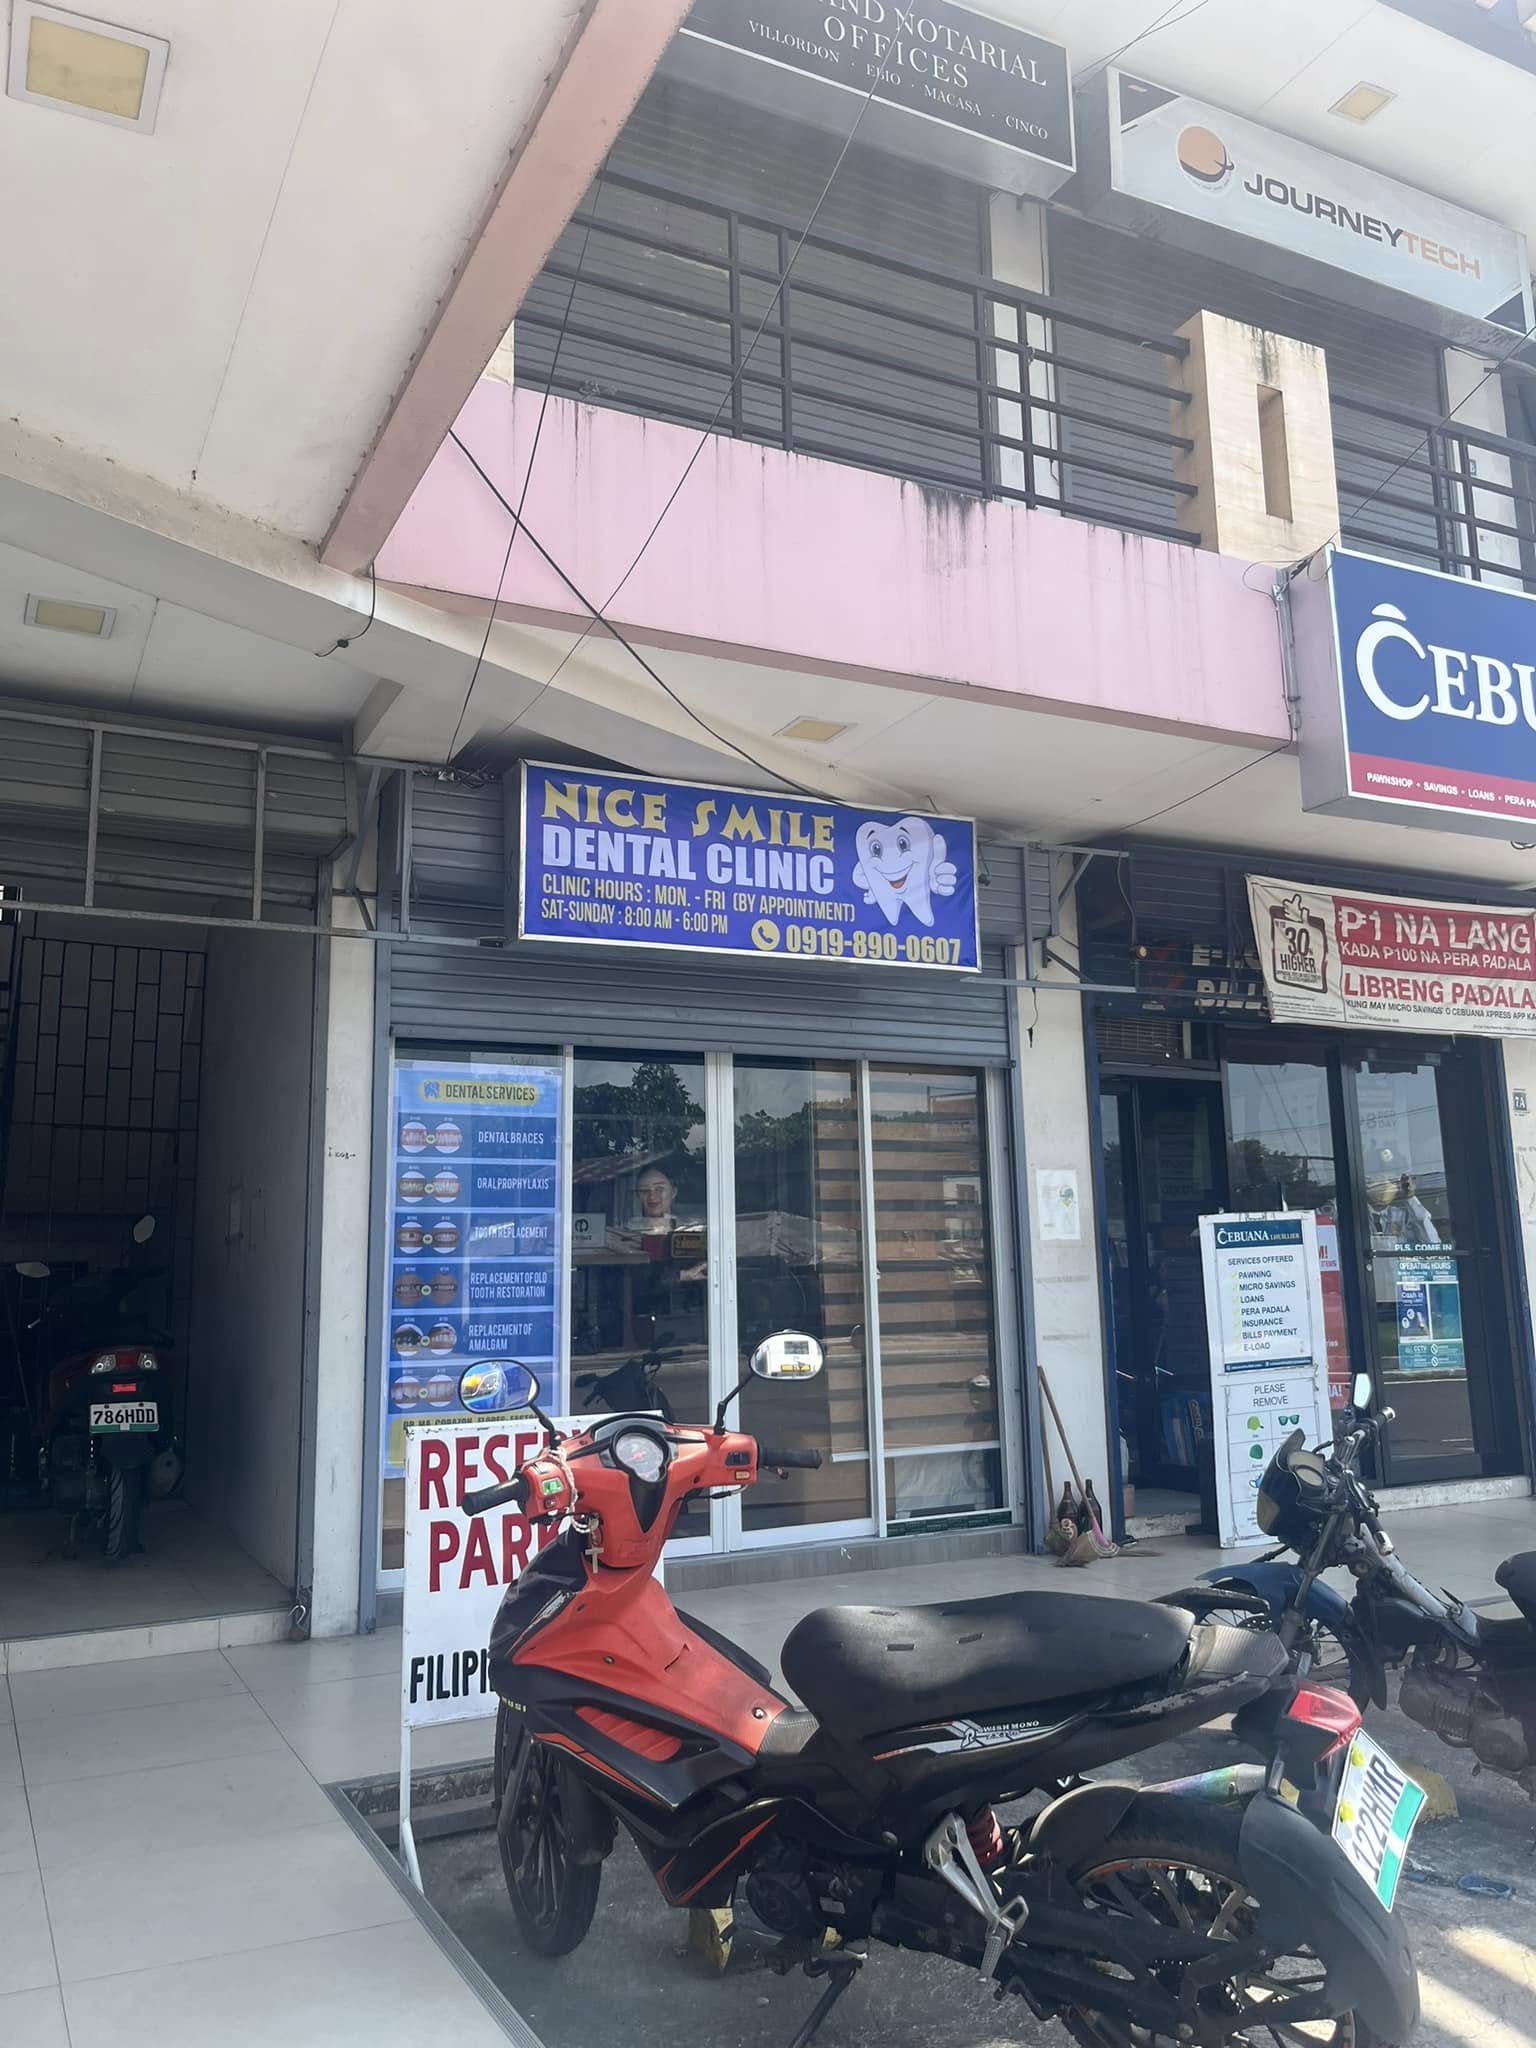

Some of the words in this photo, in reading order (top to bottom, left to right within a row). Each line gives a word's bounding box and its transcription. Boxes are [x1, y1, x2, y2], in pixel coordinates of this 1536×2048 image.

[823, 16, 970, 89] OFFICES
[894, 8, 1049, 86] NOTARIAL
[748, 19, 840, 64] VILLORDON
[924, 84, 982, 117] MACASA
[1005, 115, 1049, 141] CINCO
[1366, 772, 1414, 789] PAWNSHOP
[1423, 782, 1458, 796] SAVINGS
[1468, 789, 1495, 801] LOANS
[1504, 794, 1525, 806] PERA
[541, 779, 667, 833] NICE
[691, 800, 835, 853] SMILE
[541, 824, 697, 881] DENTAL
[706, 843, 835, 895] CLINIC
[542, 873, 591, 898] CLINIC
[654, 884, 691, 907] MON.
[704, 889, 726, 910] FRI
[733, 893, 756, 914] (BY
[759, 896, 856, 922] APPOINTMENT)
[541, 898, 616, 925] SAT-SUNDAY
[624, 906, 651, 928] 8:00
[654, 909, 672, 929] AM
[683, 911, 707, 933] 6:00
[711, 914, 728, 934] PM
[1394, 912, 1440, 947] NA
[1448, 917, 1530, 954] LANG
[786, 924, 961, 965] 0919-890-0607
[1340, 941, 1380, 959] KADA
[1421, 949, 1441, 964] NA
[1443, 952, 1480, 967] PERA
[1482, 954, 1532, 971] PADALA
[1280, 954, 1317, 973] HIGHER
[1344, 972, 1444, 1003] LIBRENG
[1451, 983, 1536, 1009] PADALA
[1345, 999, 1368, 1009] KUNG
[1369, 1001, 1386, 1011] MAY
[1388, 1003, 1411, 1013] MICRO
[1452, 1008, 1484, 1017] CEBUANA
[1486, 1010, 1511, 1020] XPRESS
[1513, 1012, 1525, 1020] APP
[445, 1084, 484, 1099] DENTAL
[486, 1085, 535, 1101] SERVICES
[478, 1131, 510, 1144] DENTAL
[510, 1132, 544, 1144] BRACES
[477, 1178, 498, 1190] ORAL
[498, 1178, 549, 1190] PROPHYLAXIS
[498, 1226, 548, 1239] REPLACEMENT
[1217, 1228, 1269, 1245] CEBUANA
[1228, 1257, 1261, 1266] SERVICES
[1262, 1255, 1294, 1264] OFFERED
[1400, 1262, 1430, 1270] OPERATING
[470, 1272, 525, 1284] REPLACEMENT
[525, 1272, 534, 1283] OF
[534, 1272, 547, 1283] OLD
[1238, 1270, 1272, 1279] PAWNING
[470, 1286, 495, 1298] TOOTH
[496, 1286, 545, 1298] RESTORATION
[1239, 1283, 1263, 1291] MICRO
[1265, 1281, 1296, 1289] SAVINGS
[1240, 1295, 1265, 1303] LOANS
[1241, 1307, 1260, 1315] PERA
[1262, 1305, 1290, 1314] PADALA
[1242, 1317, 1284, 1327] INSURANCE
[469, 1324, 523, 1336] REPLACEMENT
[523, 1323, 533, 1335] OF
[1242, 1331, 1262, 1339] BILLS
[1264, 1328, 1298, 1337] PAYMENT
[469, 1339, 508, 1350] AMALGAM
[1244, 1342, 1270, 1351] E-LOAD
[1254, 1383, 1286, 1394] PLEASE
[1253, 1396, 1288, 1407] REMOVE
[93, 1408, 155, 1425] 786HDD
[410, 1648, 496, 1703] FILIPI
[1011, 1720, 1039, 1729] MONO
